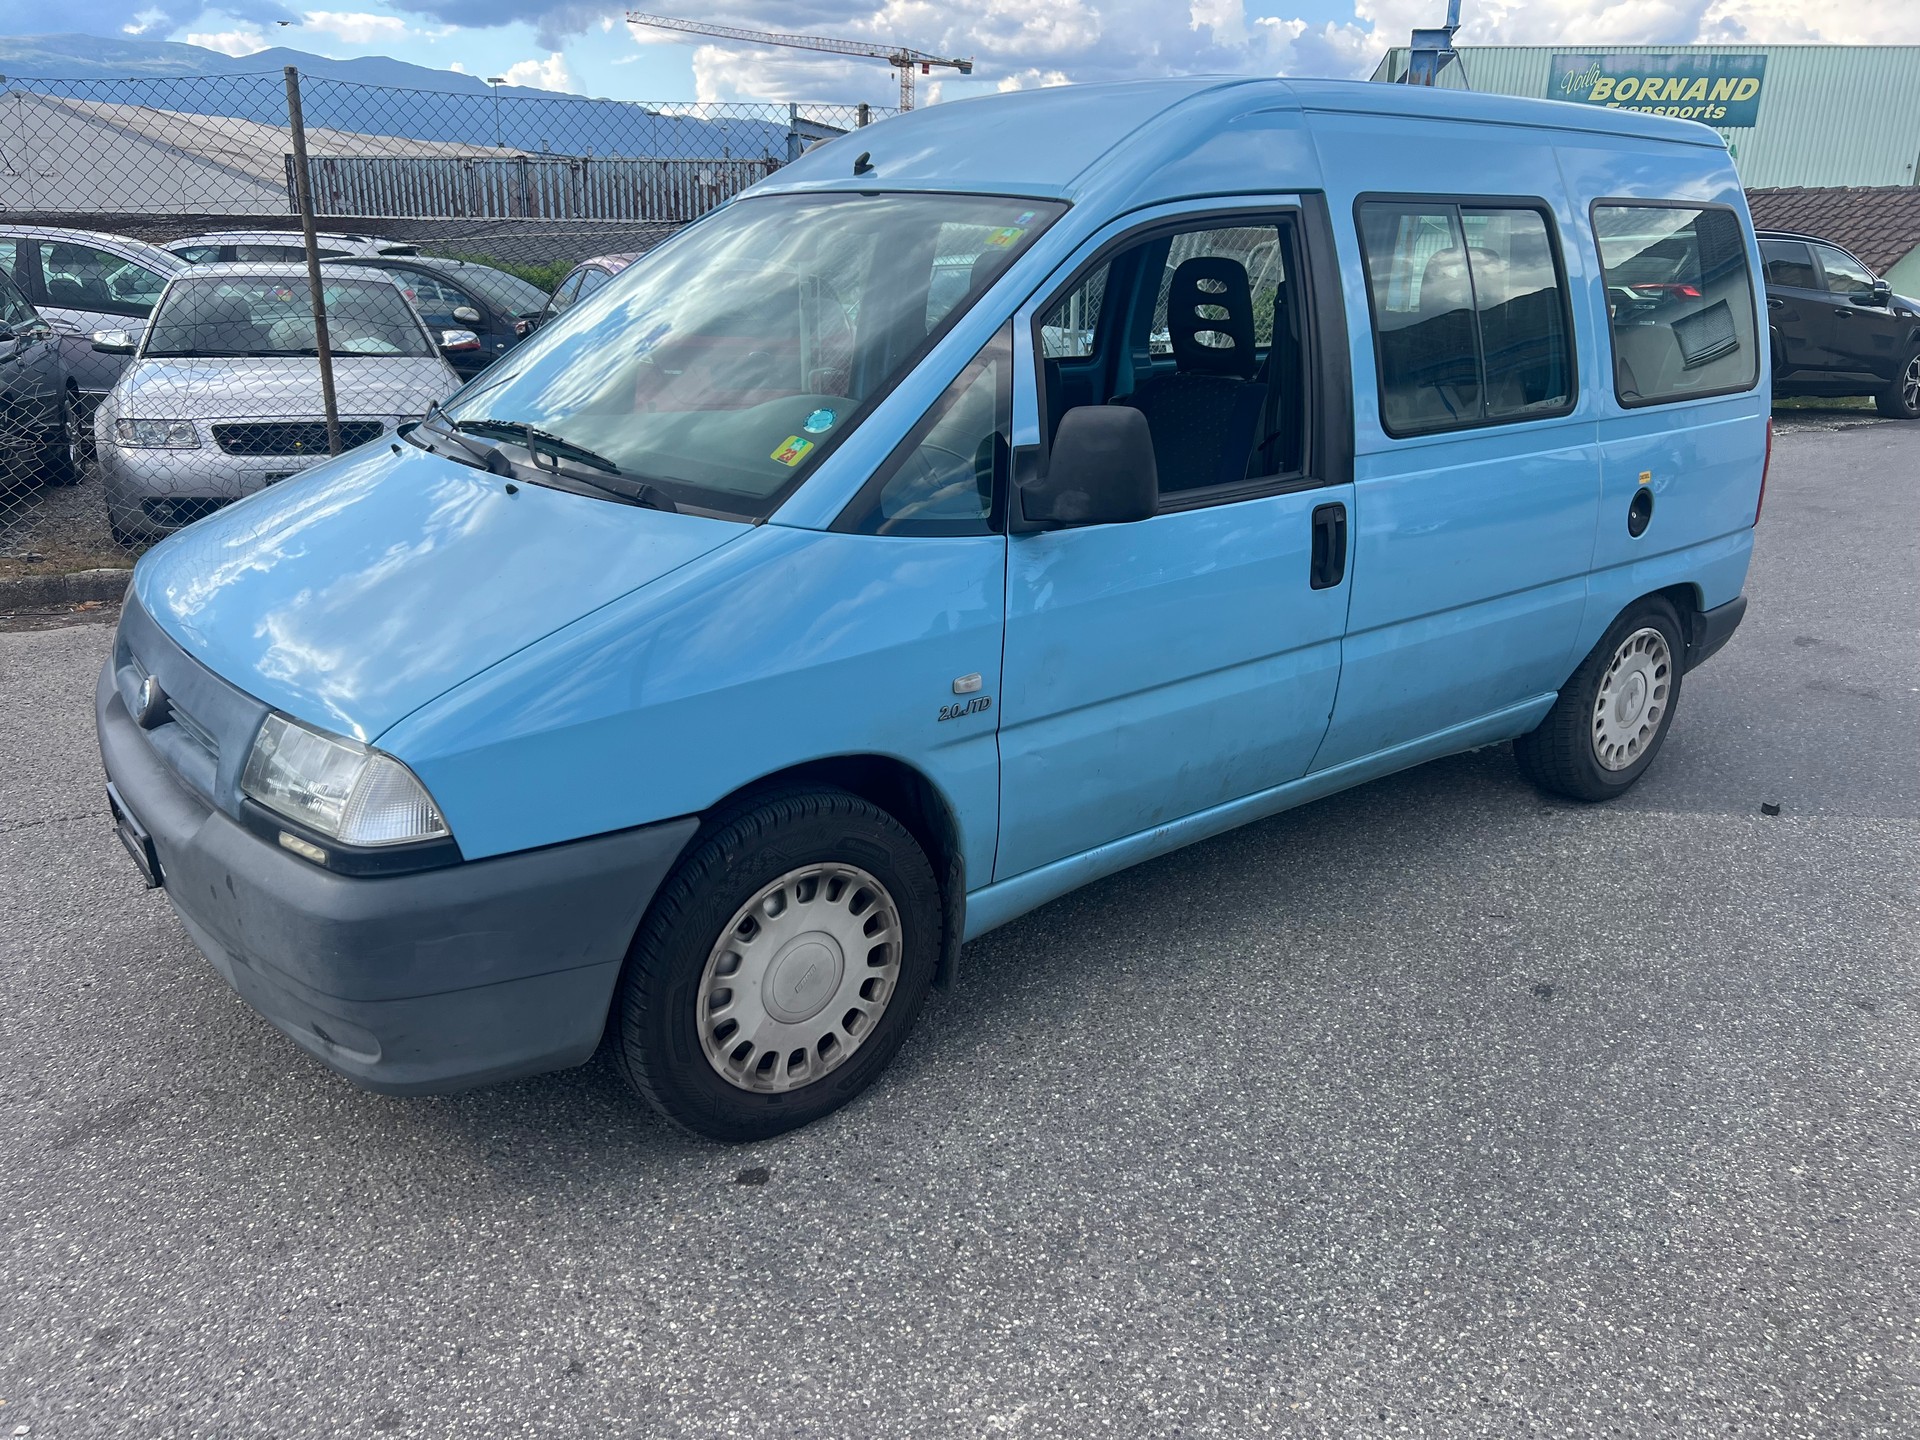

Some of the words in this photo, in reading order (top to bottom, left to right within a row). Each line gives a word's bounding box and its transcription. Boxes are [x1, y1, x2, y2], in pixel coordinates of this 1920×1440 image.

[1560, 61, 1603, 95] Voilà
[1587, 77, 1760, 101] BORNAND
[1605, 102, 1727, 119] nsports
[779, 448, 798, 462] 23
